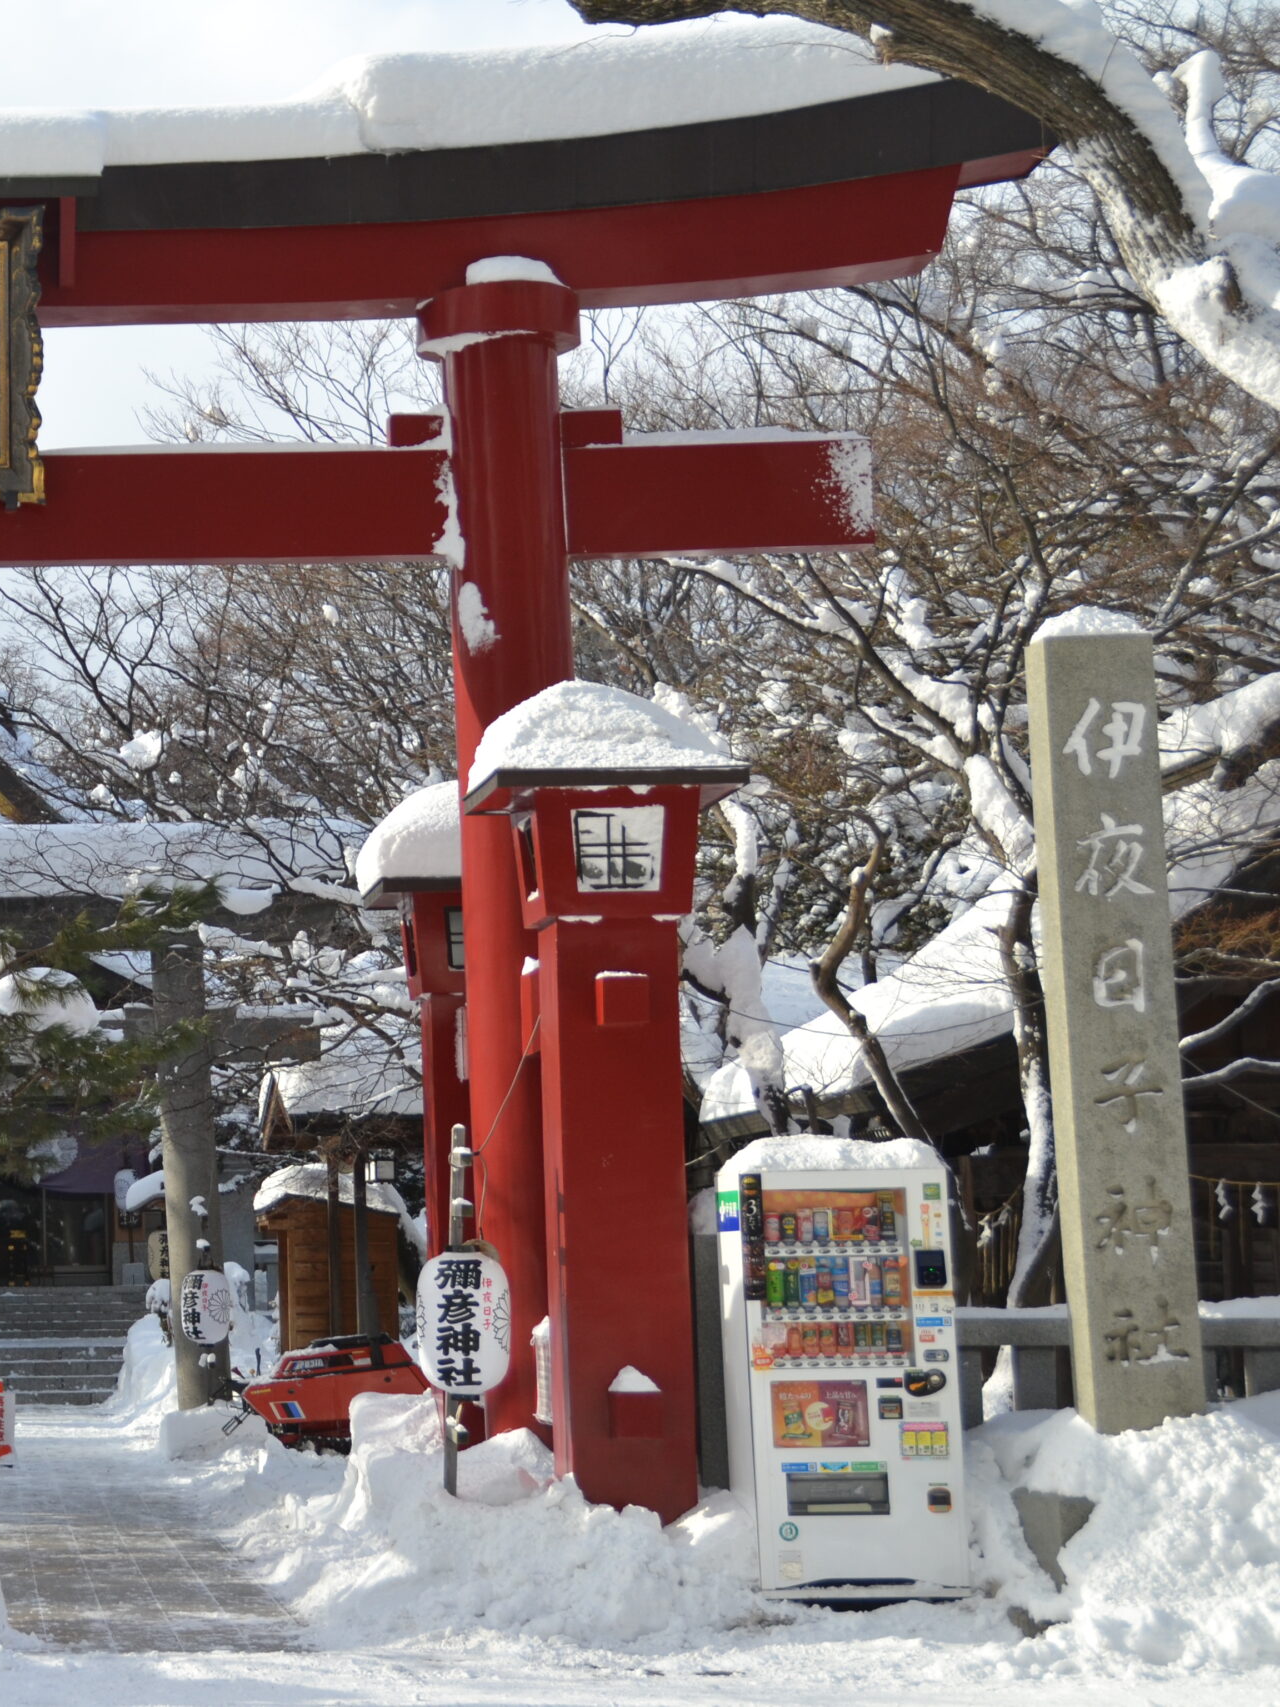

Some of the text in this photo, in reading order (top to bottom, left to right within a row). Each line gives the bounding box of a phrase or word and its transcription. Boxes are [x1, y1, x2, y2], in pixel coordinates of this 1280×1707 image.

[1062, 697, 1190, 1367] 伊夜日子神社
[182, 1273, 207, 1340] 彌彦神社
[434, 1258, 483, 1387] 彌彦神社
[482, 1277, 493, 1331] 伊夜日子
